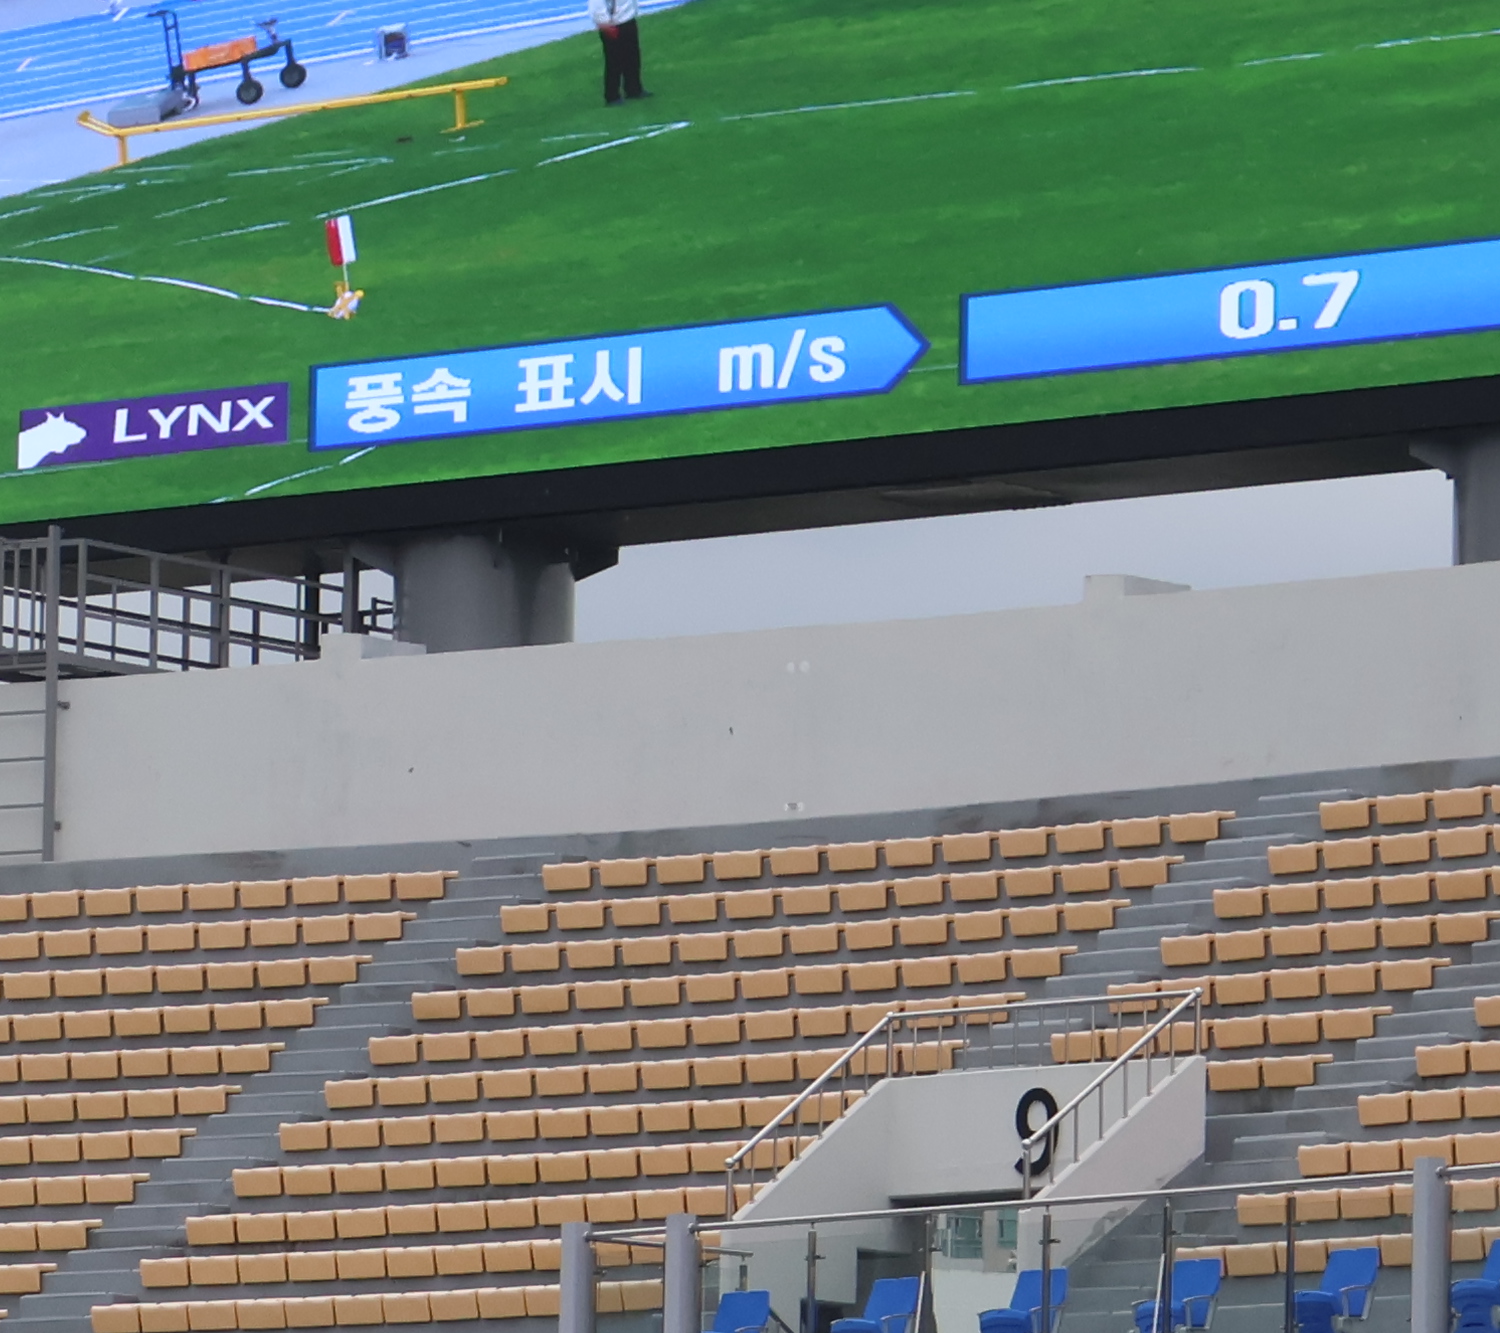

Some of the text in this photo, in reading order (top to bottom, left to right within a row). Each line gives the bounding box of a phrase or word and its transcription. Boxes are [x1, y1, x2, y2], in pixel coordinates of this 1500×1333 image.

[1217, 271, 1359, 340] 0.7
[112, 394, 275, 446] LYNX
[344, 328, 846, 434] 풍속 표시 m/s
[1014, 1087, 1059, 1176] 9
